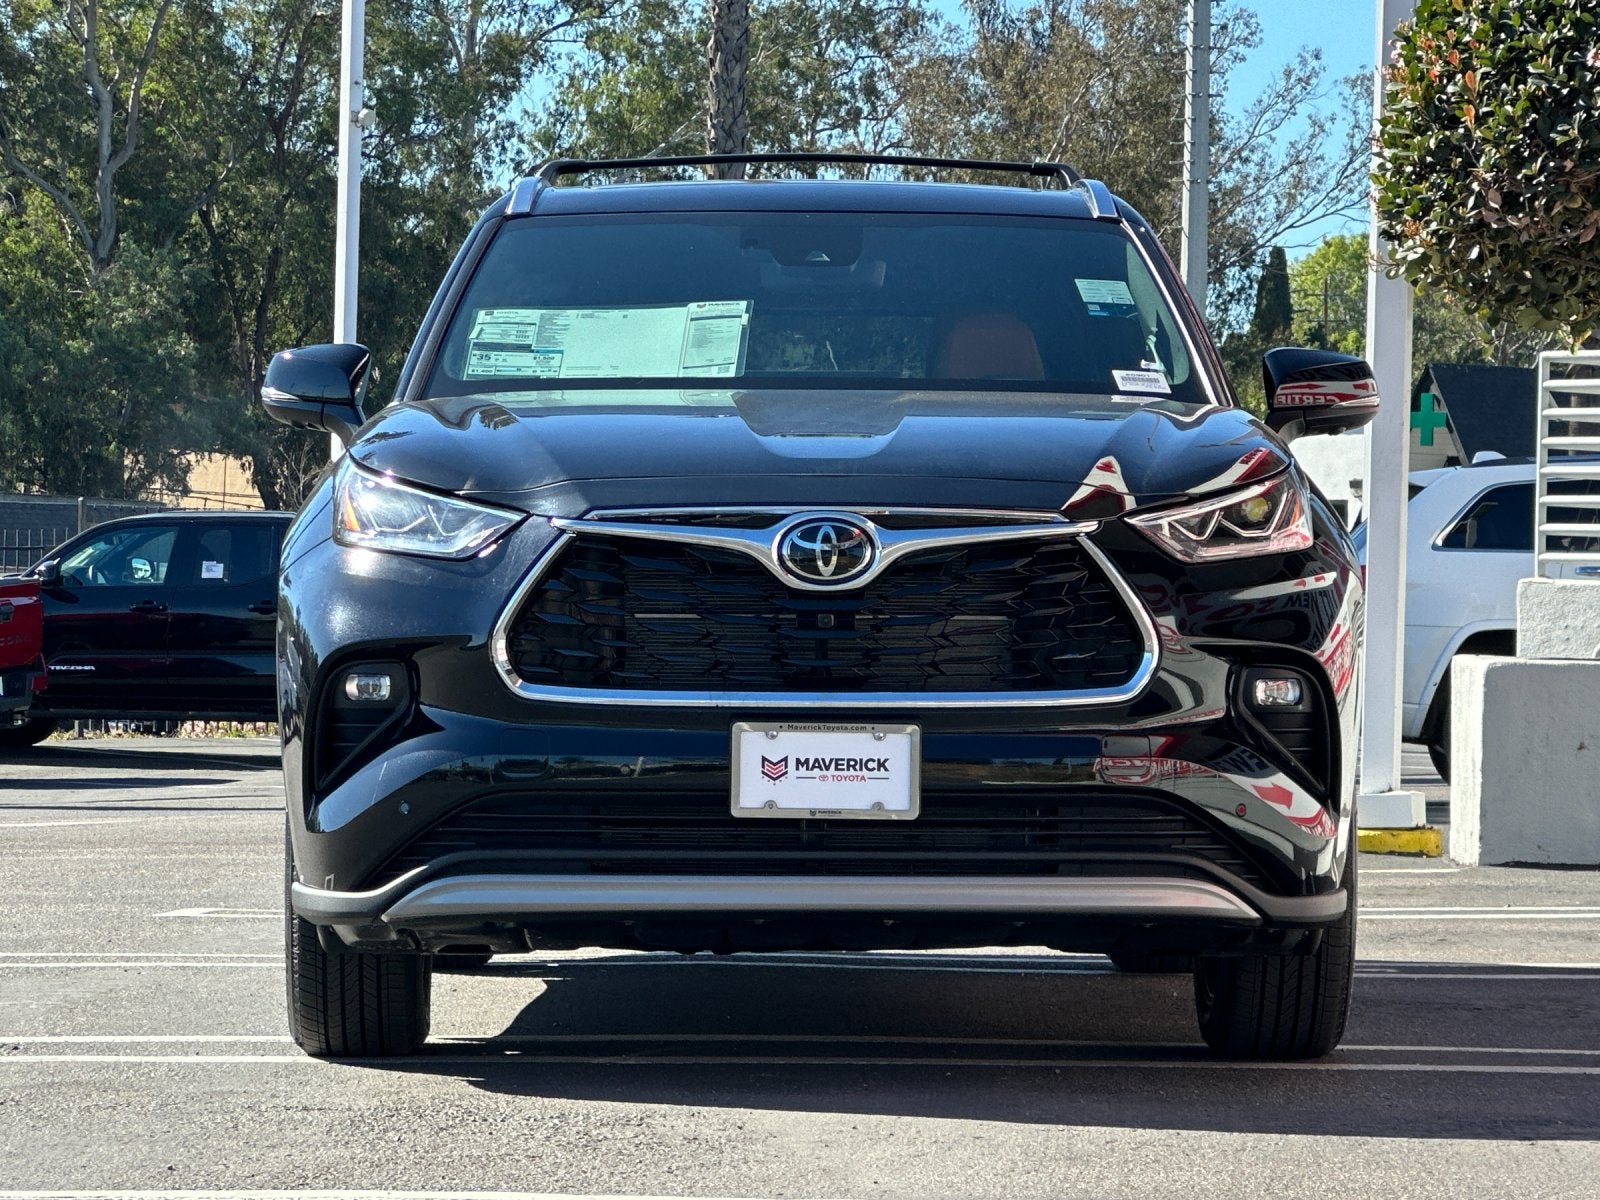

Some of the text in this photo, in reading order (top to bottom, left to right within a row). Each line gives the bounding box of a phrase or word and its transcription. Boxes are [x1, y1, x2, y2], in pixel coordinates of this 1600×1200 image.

[477, 352, 492, 361] 35
[787, 724, 867, 732] MaverickToyota.com
[795, 757, 890, 772] MAVERICK
[831, 774, 867, 782] TOYOTA
